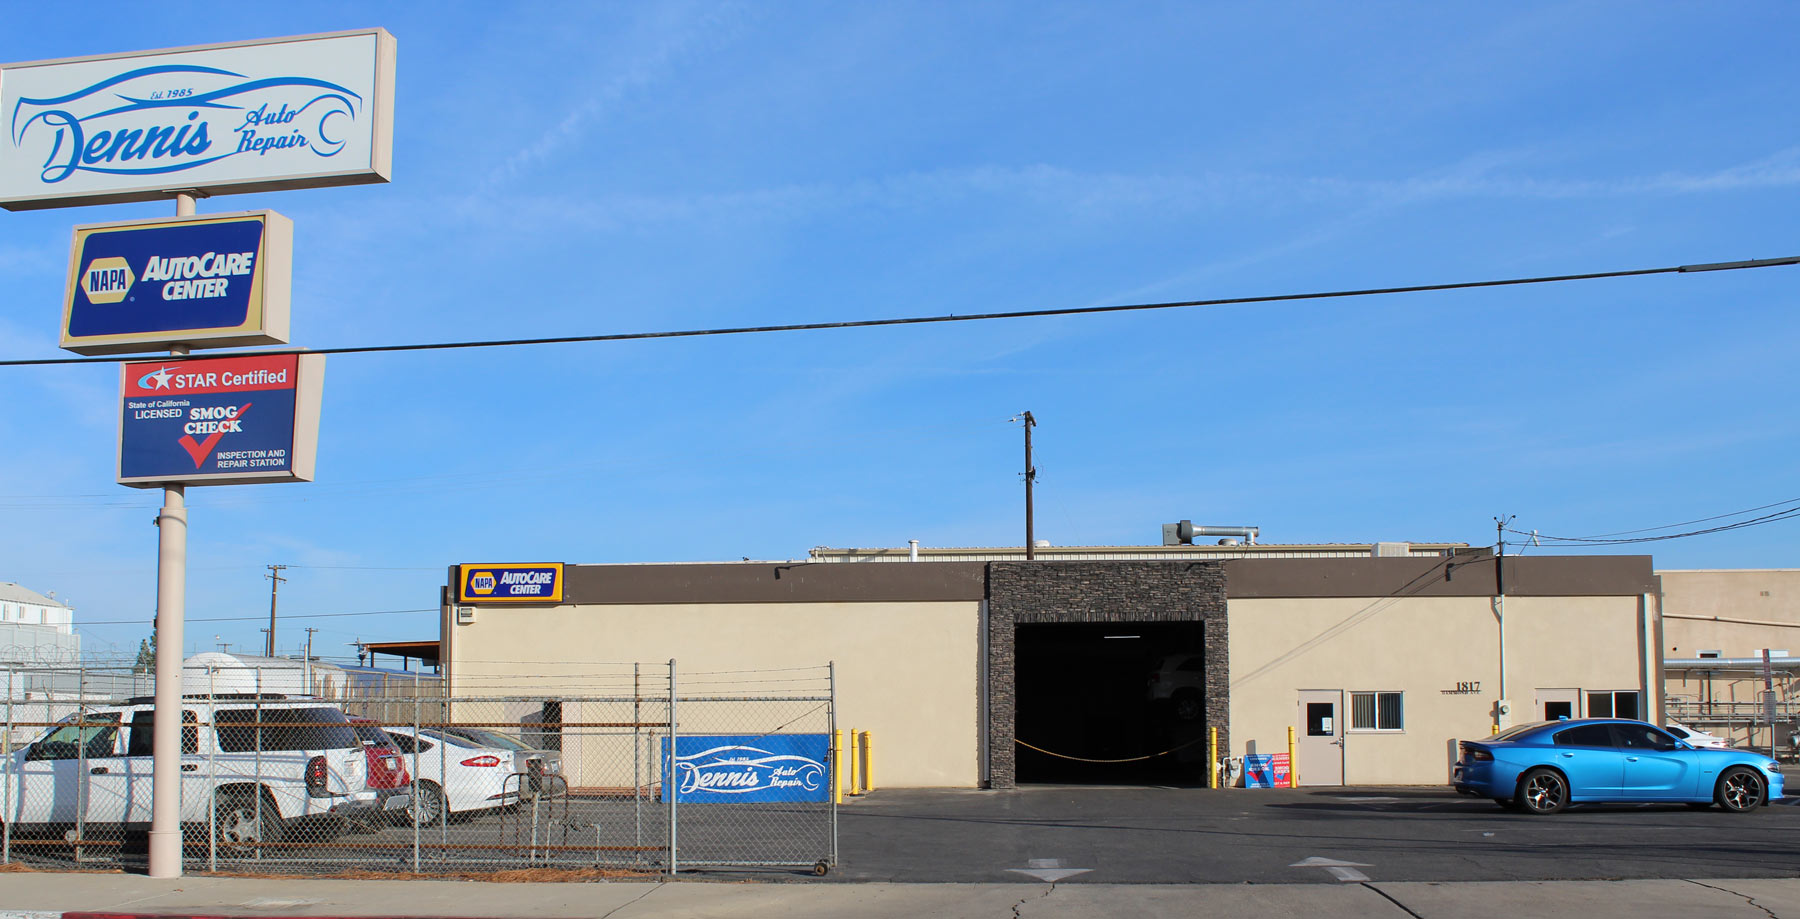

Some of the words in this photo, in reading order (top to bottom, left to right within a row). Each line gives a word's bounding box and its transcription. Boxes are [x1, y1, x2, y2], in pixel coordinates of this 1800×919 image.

[150, 91, 164, 100] Est.
[166, 87, 194, 99] 1985
[234, 102, 297, 132] Auto
[41, 109, 212, 183] Dennis
[237, 128, 310, 155] Repair
[90, 268, 127, 292] NAPA
[162, 278, 229, 301] CENTER
[175, 372, 217, 389] STAR
[221, 368, 287, 386] Certified
[156, 399, 191, 408] California
[135, 409, 182, 420] LICENSED
[190, 406, 238, 421] SMOG
[184, 420, 243, 435] CHECK
[217, 450, 266, 460] INSPECTION
[267, 449, 286, 458] AND
[217, 460, 249, 468] REPAIR
[249, 458, 285, 467] STATION
[475, 578, 493, 588] NAPA
[510, 584, 541, 595] CENTER
[1456, 682, 1481, 692] 1817
[680, 762, 759, 794] Dennis
[768, 765, 798, 778] Auto
[770, 776, 804, 789] Repair
